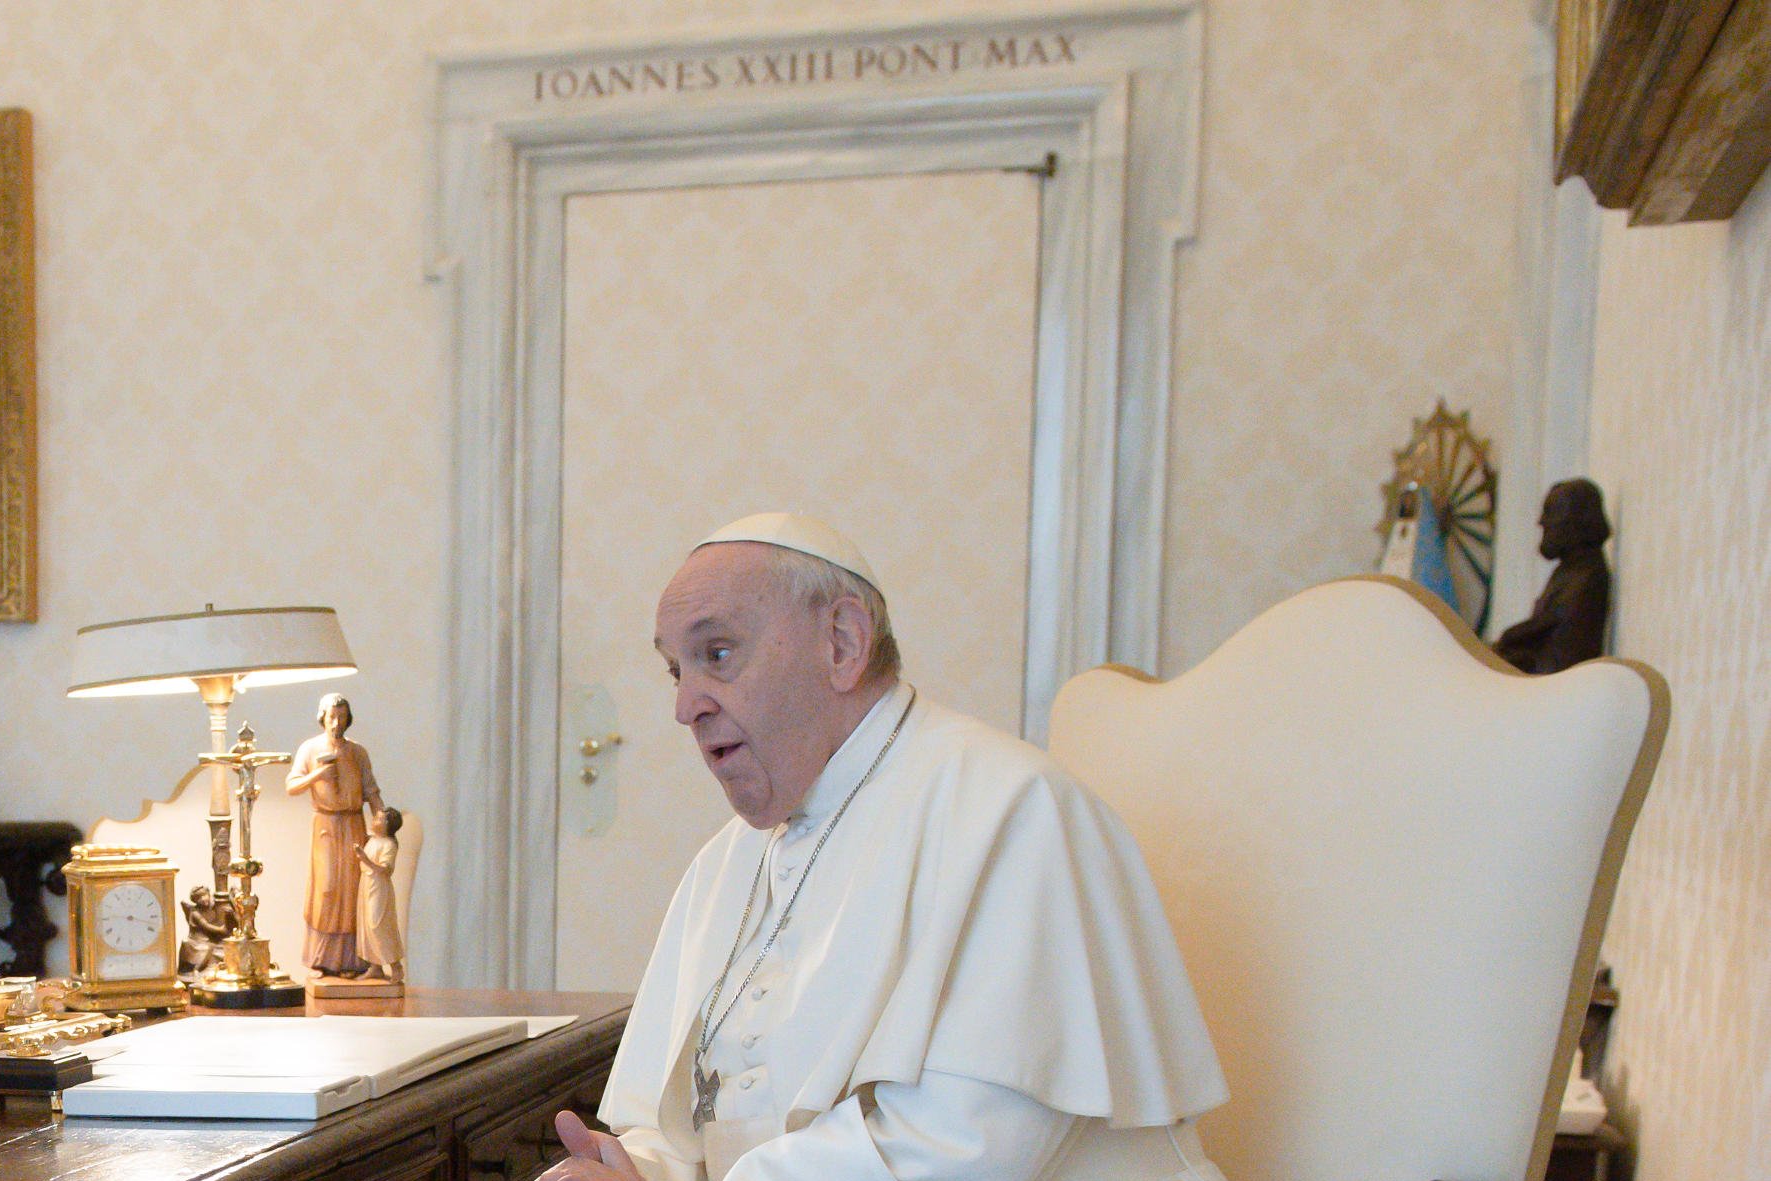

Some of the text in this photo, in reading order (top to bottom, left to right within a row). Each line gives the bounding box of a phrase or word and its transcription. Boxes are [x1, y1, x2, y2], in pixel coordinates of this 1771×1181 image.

[534, 34, 1076, 101] IOANNES XXIII PONT MAX
